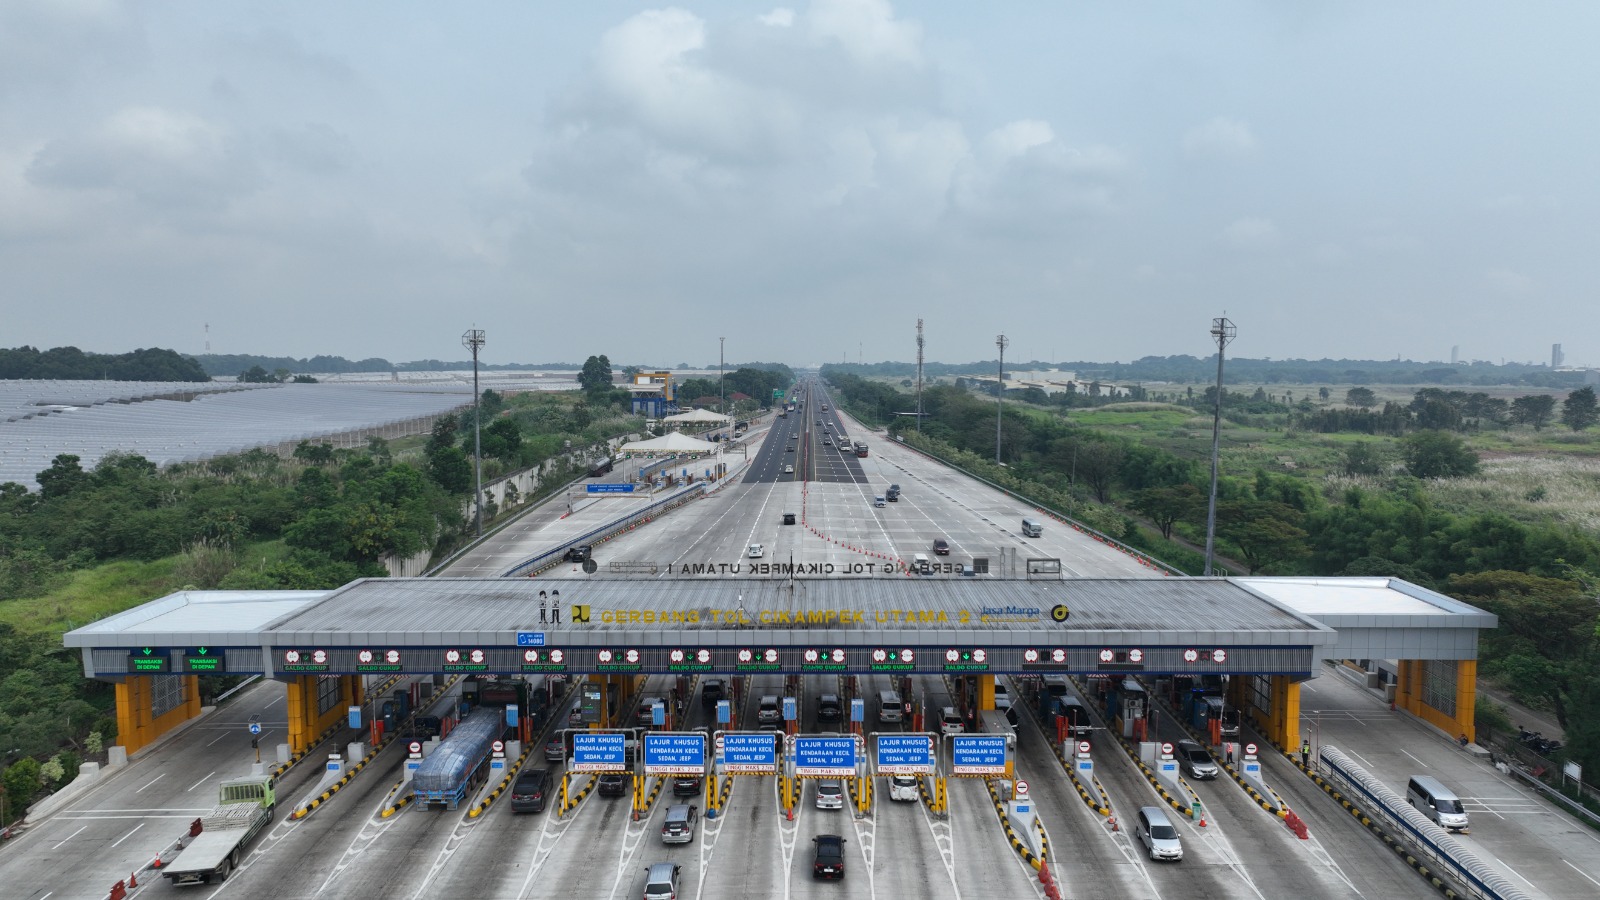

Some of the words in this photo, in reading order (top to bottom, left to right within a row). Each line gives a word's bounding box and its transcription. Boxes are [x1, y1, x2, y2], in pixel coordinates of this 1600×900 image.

[601, 610, 699, 624] GERBANG
[710, 610, 750, 624] TOL
[760, 610, 864, 624] CIKAMPEK
[875, 610, 948, 624] UTAMA
[959, 610, 970, 624] 2
[981, 606, 1003, 615] Jasa
[1006, 606, 1040, 617] Marga
